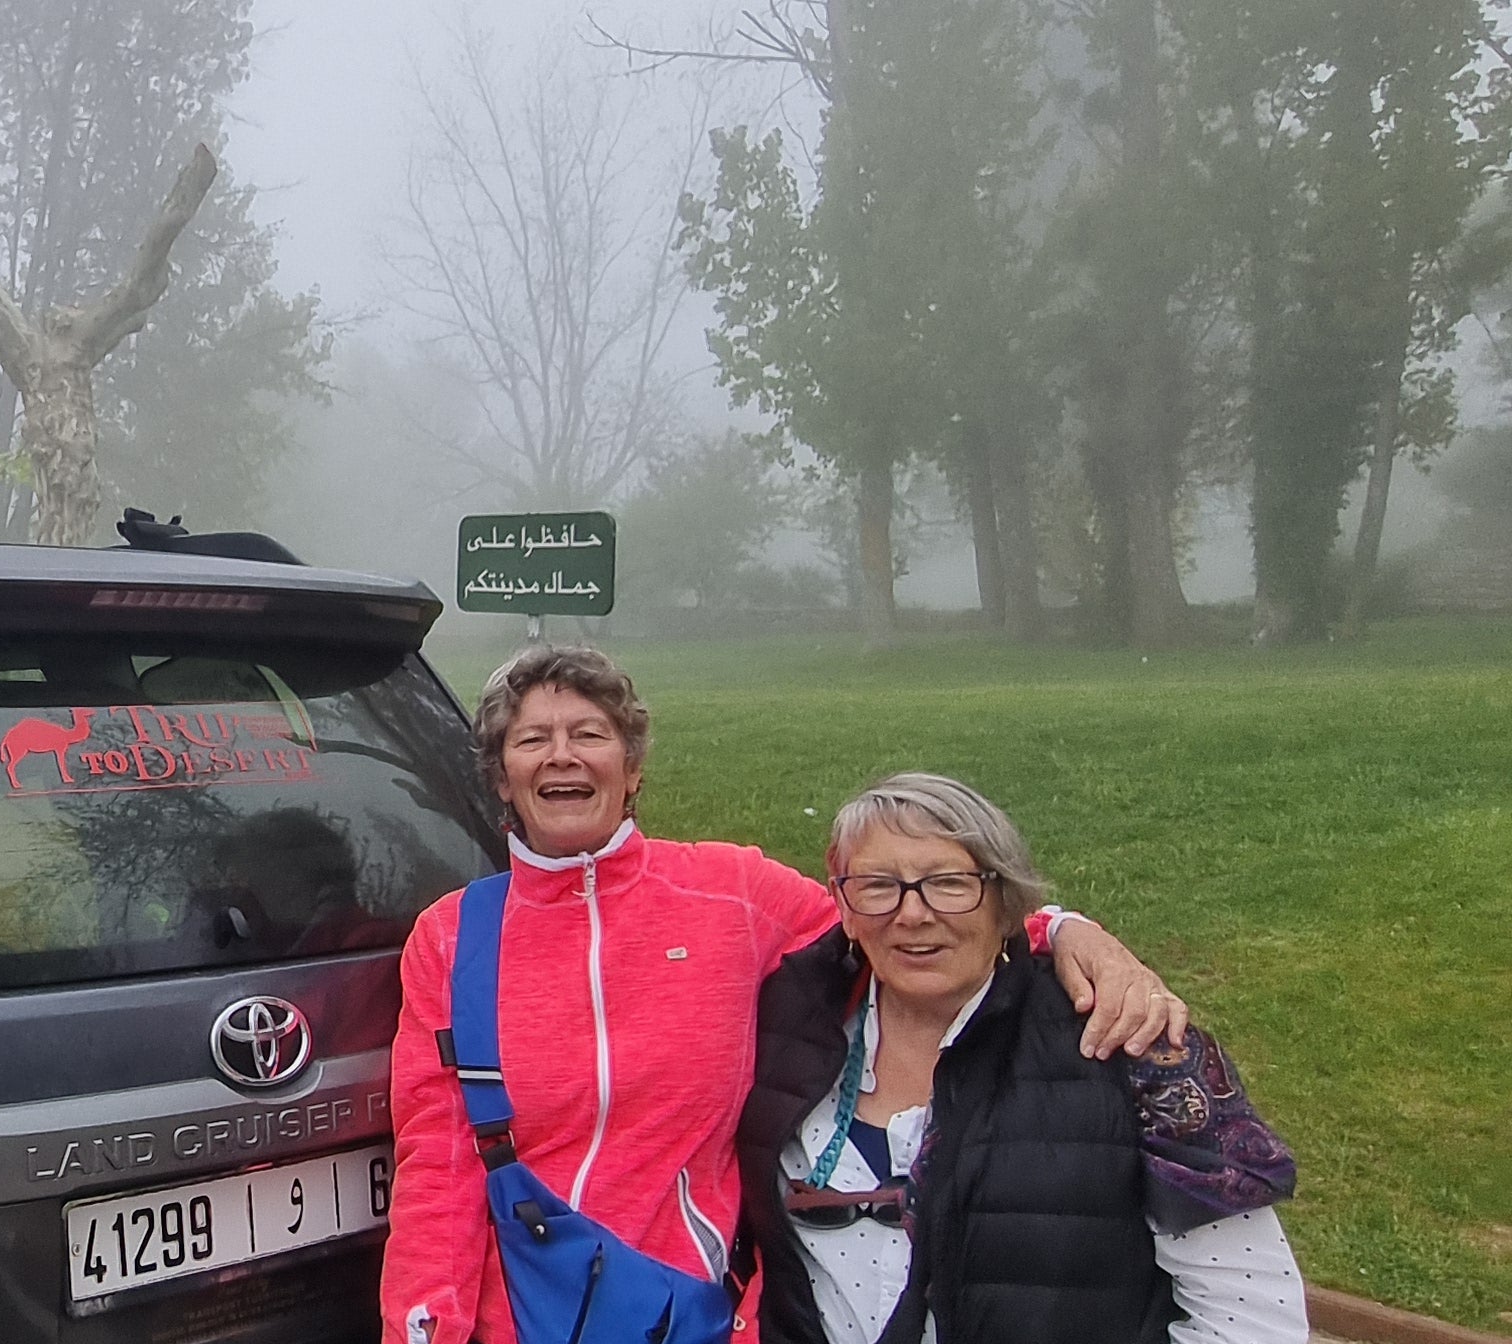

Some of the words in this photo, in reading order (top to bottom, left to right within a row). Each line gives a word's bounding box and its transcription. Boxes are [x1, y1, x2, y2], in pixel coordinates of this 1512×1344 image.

[467, 526, 515, 552] على
[519, 523, 603, 557] حافظوا
[463, 569, 540, 600] مدينتكم
[544, 570, 600, 600] جمال
[82, 751, 129, 775] TO
[26, 1132, 157, 1182] LAND
[173, 1097, 353, 1158] CRUISER
[83, 1196, 214, 1285] 41299
[288, 1177, 304, 1235] و
